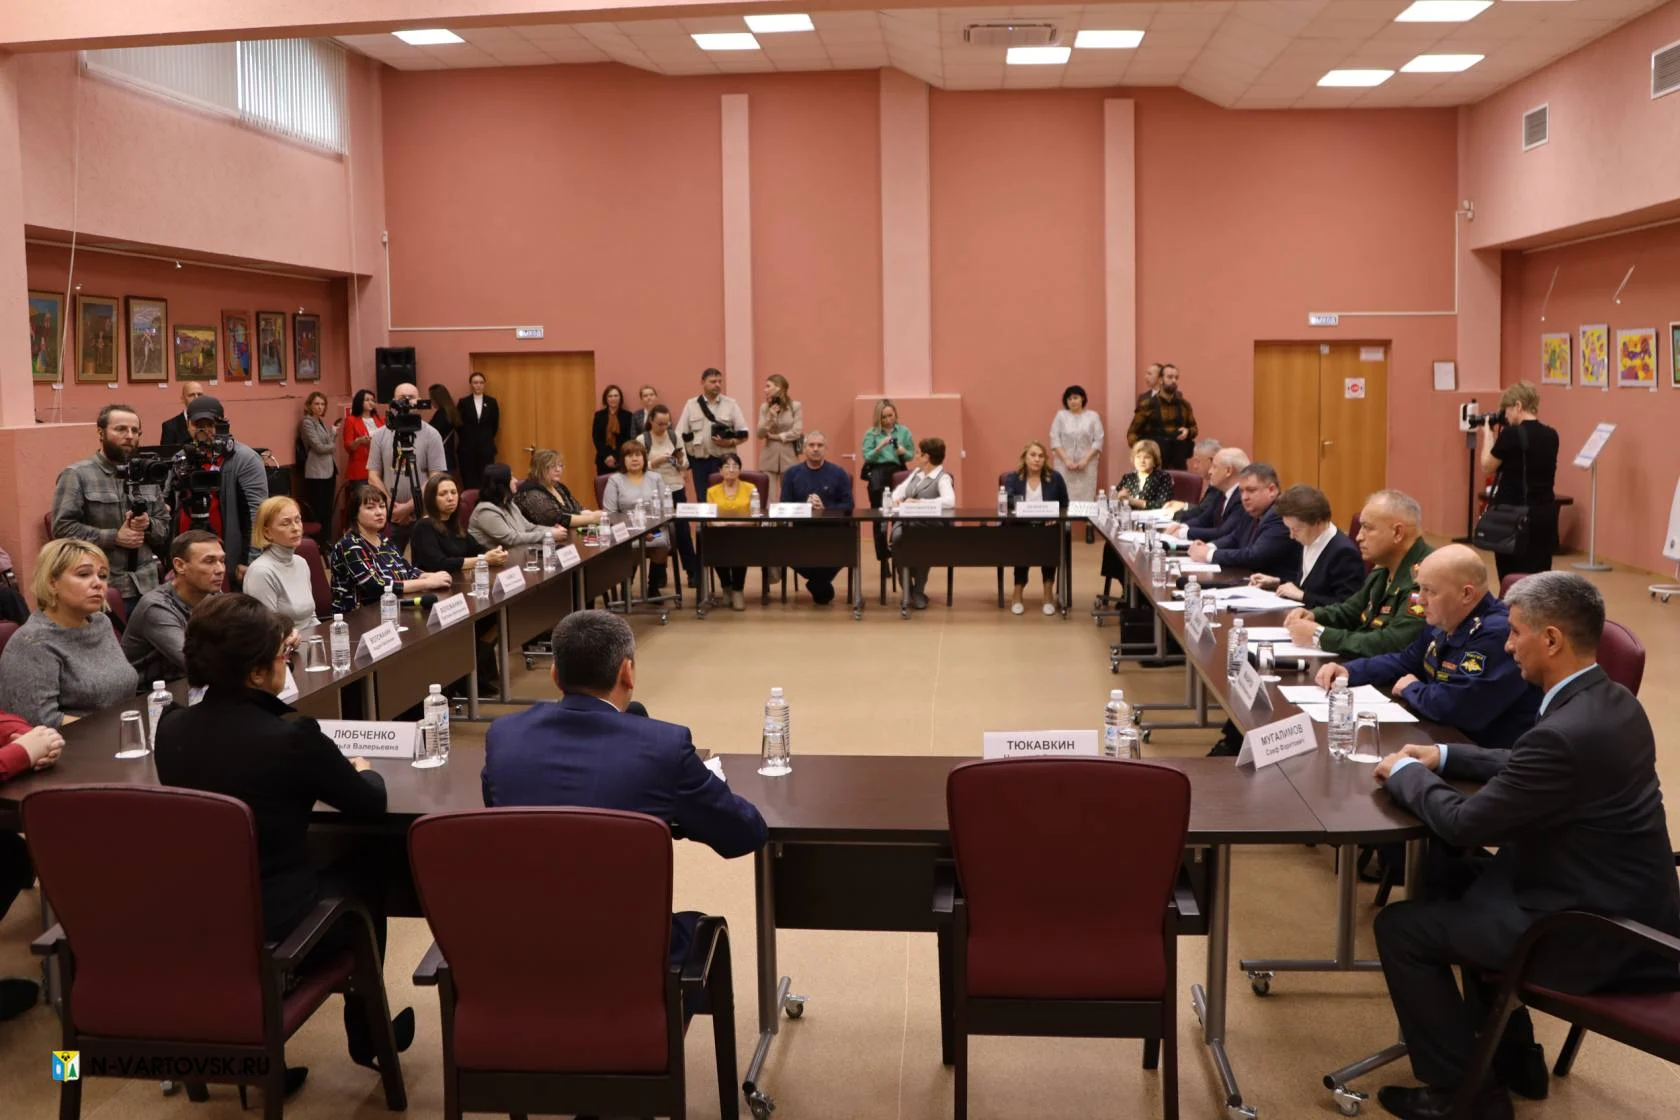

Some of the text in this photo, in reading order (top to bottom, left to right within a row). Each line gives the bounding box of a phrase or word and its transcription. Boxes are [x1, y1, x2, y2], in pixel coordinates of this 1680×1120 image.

[333, 729, 396, 740] ЛЮБЧЕНКО
[1260, 723, 1304, 746] МУГАЛИМОВ
[352, 742, 399, 752] Валерьевна
[1007, 740, 1075, 750] ТЮКАВКИН
